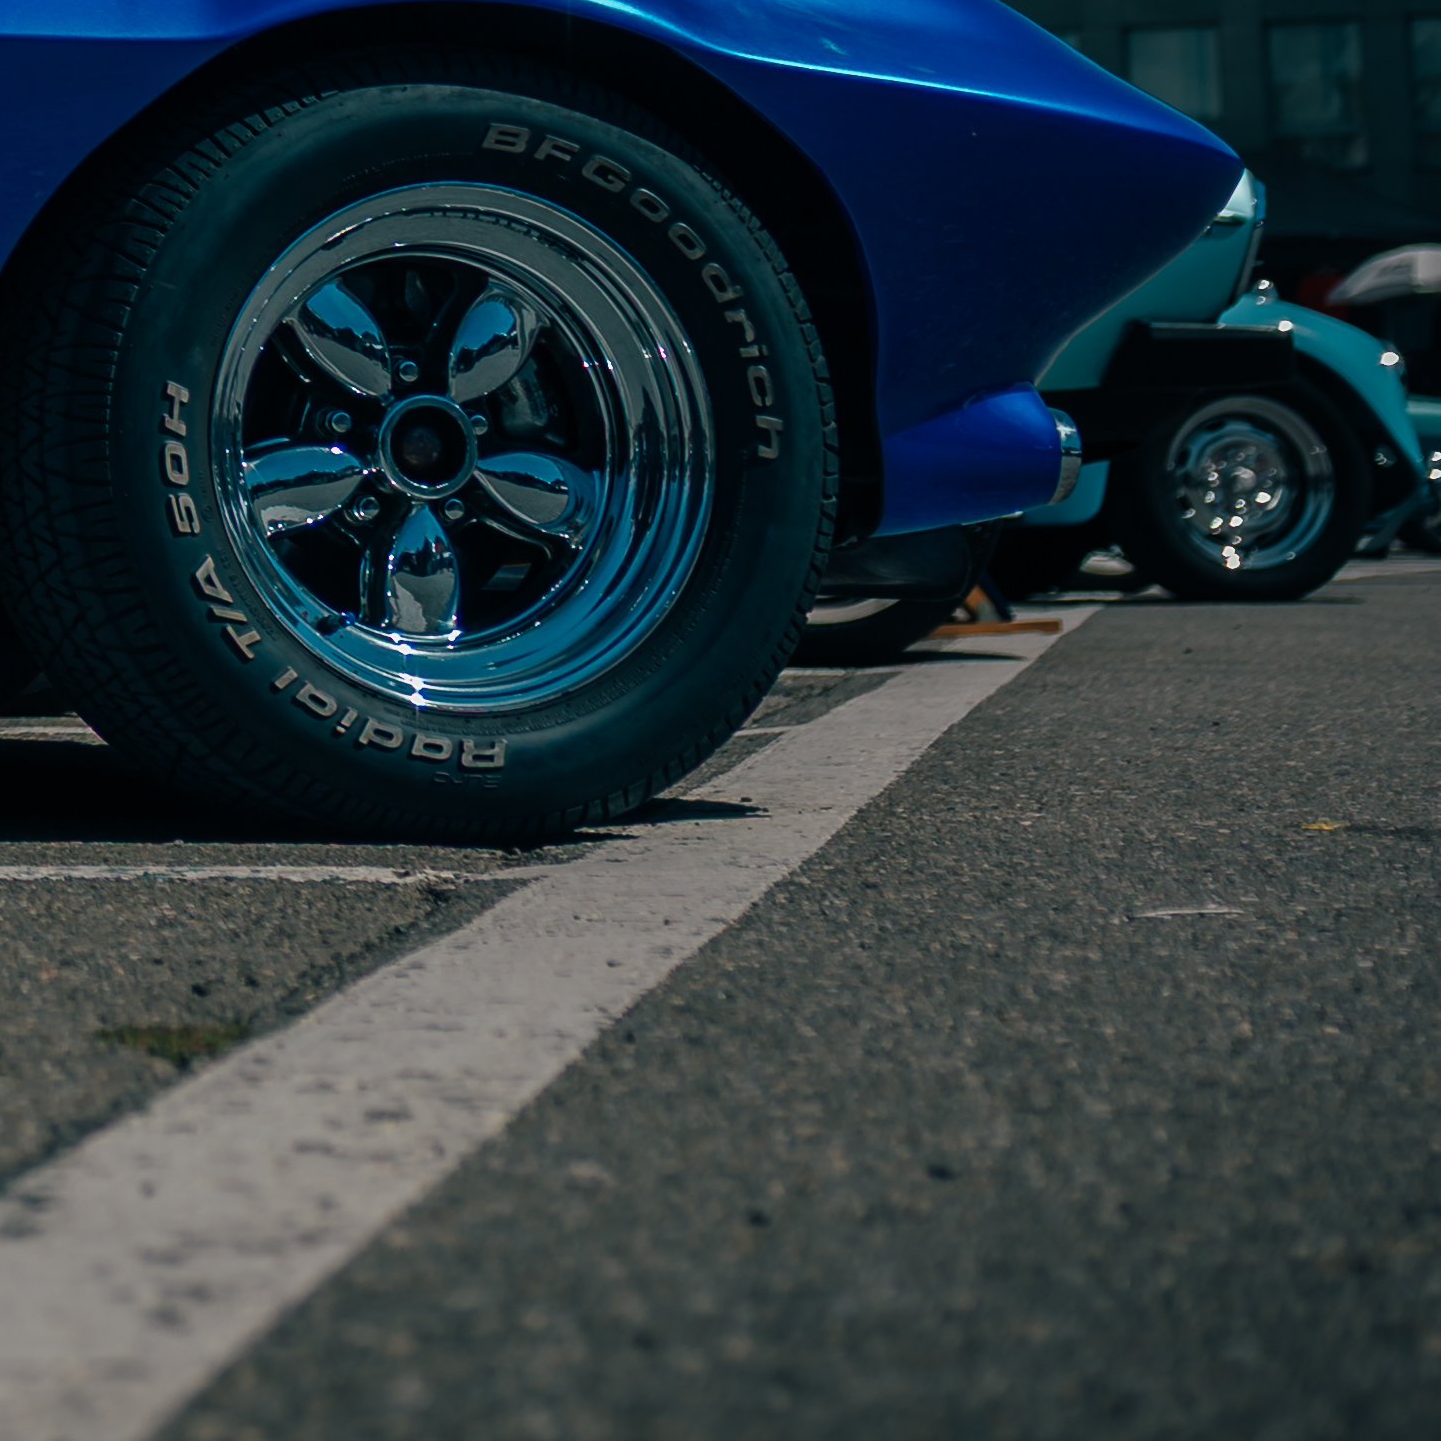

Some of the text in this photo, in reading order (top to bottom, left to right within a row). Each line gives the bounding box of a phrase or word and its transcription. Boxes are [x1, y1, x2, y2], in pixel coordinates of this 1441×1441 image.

[481, 123, 785, 459] BFGoodrich
[193, 553, 263, 660] T/A
[270, 666, 510, 769] Radial
